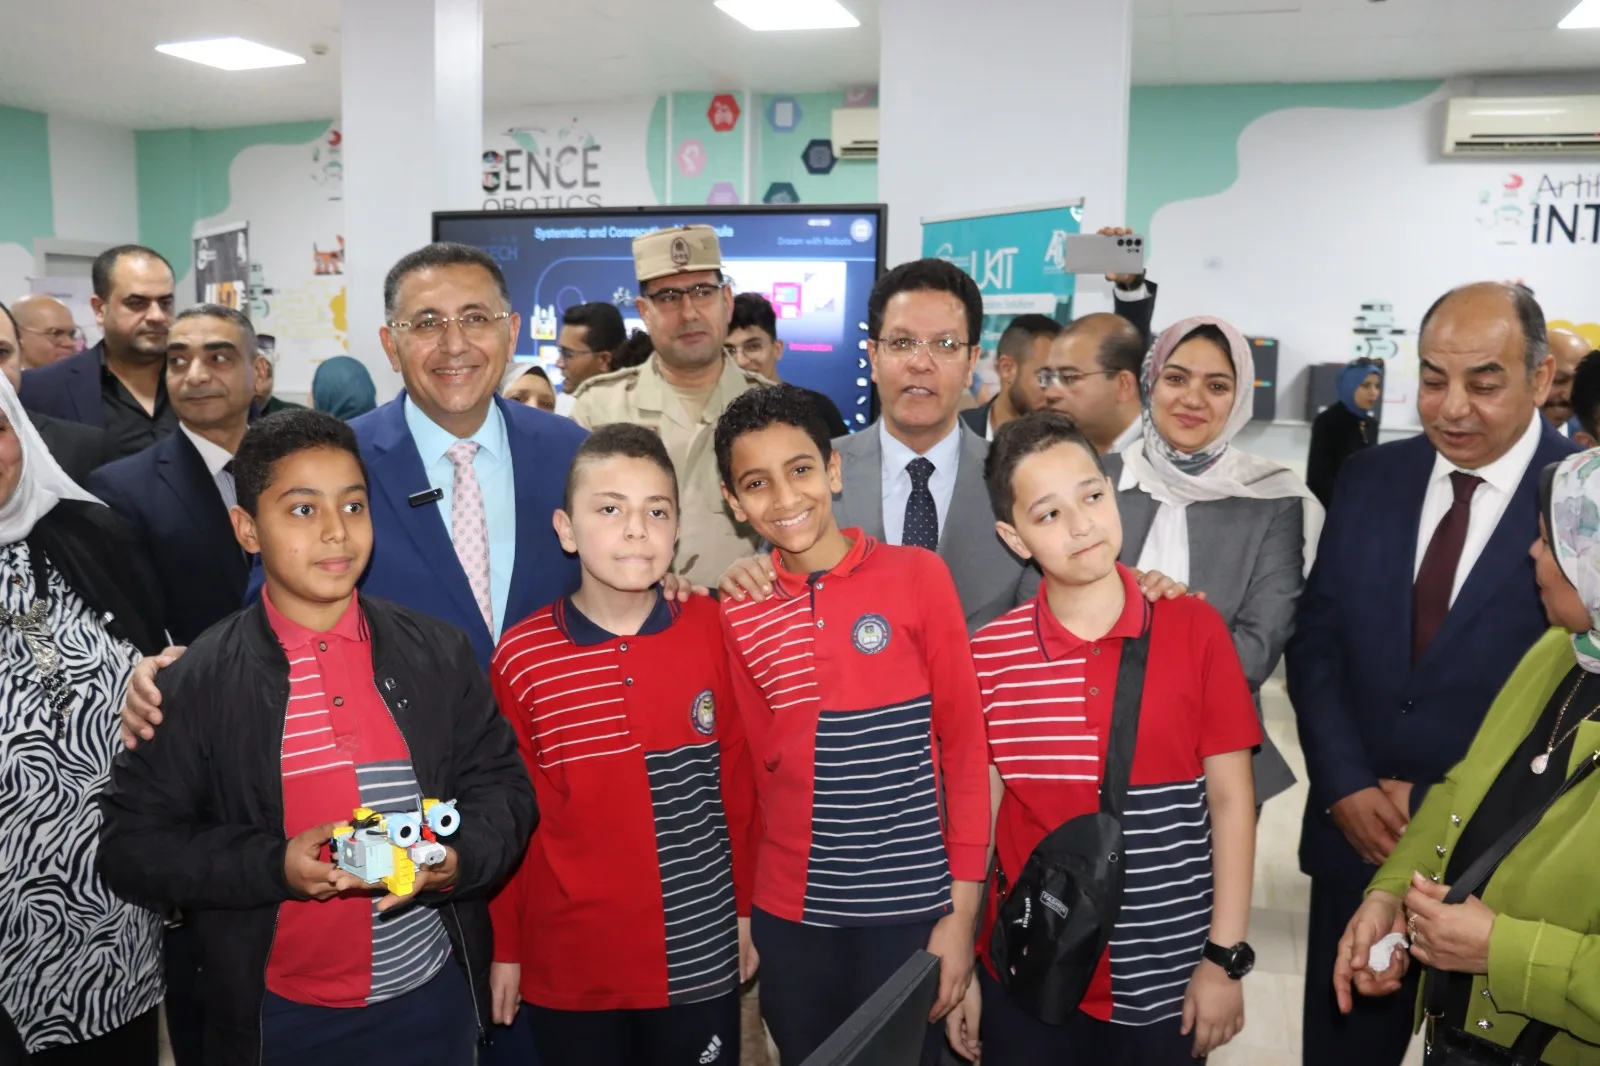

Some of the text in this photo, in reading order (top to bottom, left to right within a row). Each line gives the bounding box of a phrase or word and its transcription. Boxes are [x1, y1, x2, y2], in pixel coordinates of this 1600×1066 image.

[534, 227, 586, 241] Systematic
[589, 227, 607, 239] and
[806, 236, 823, 246] with
